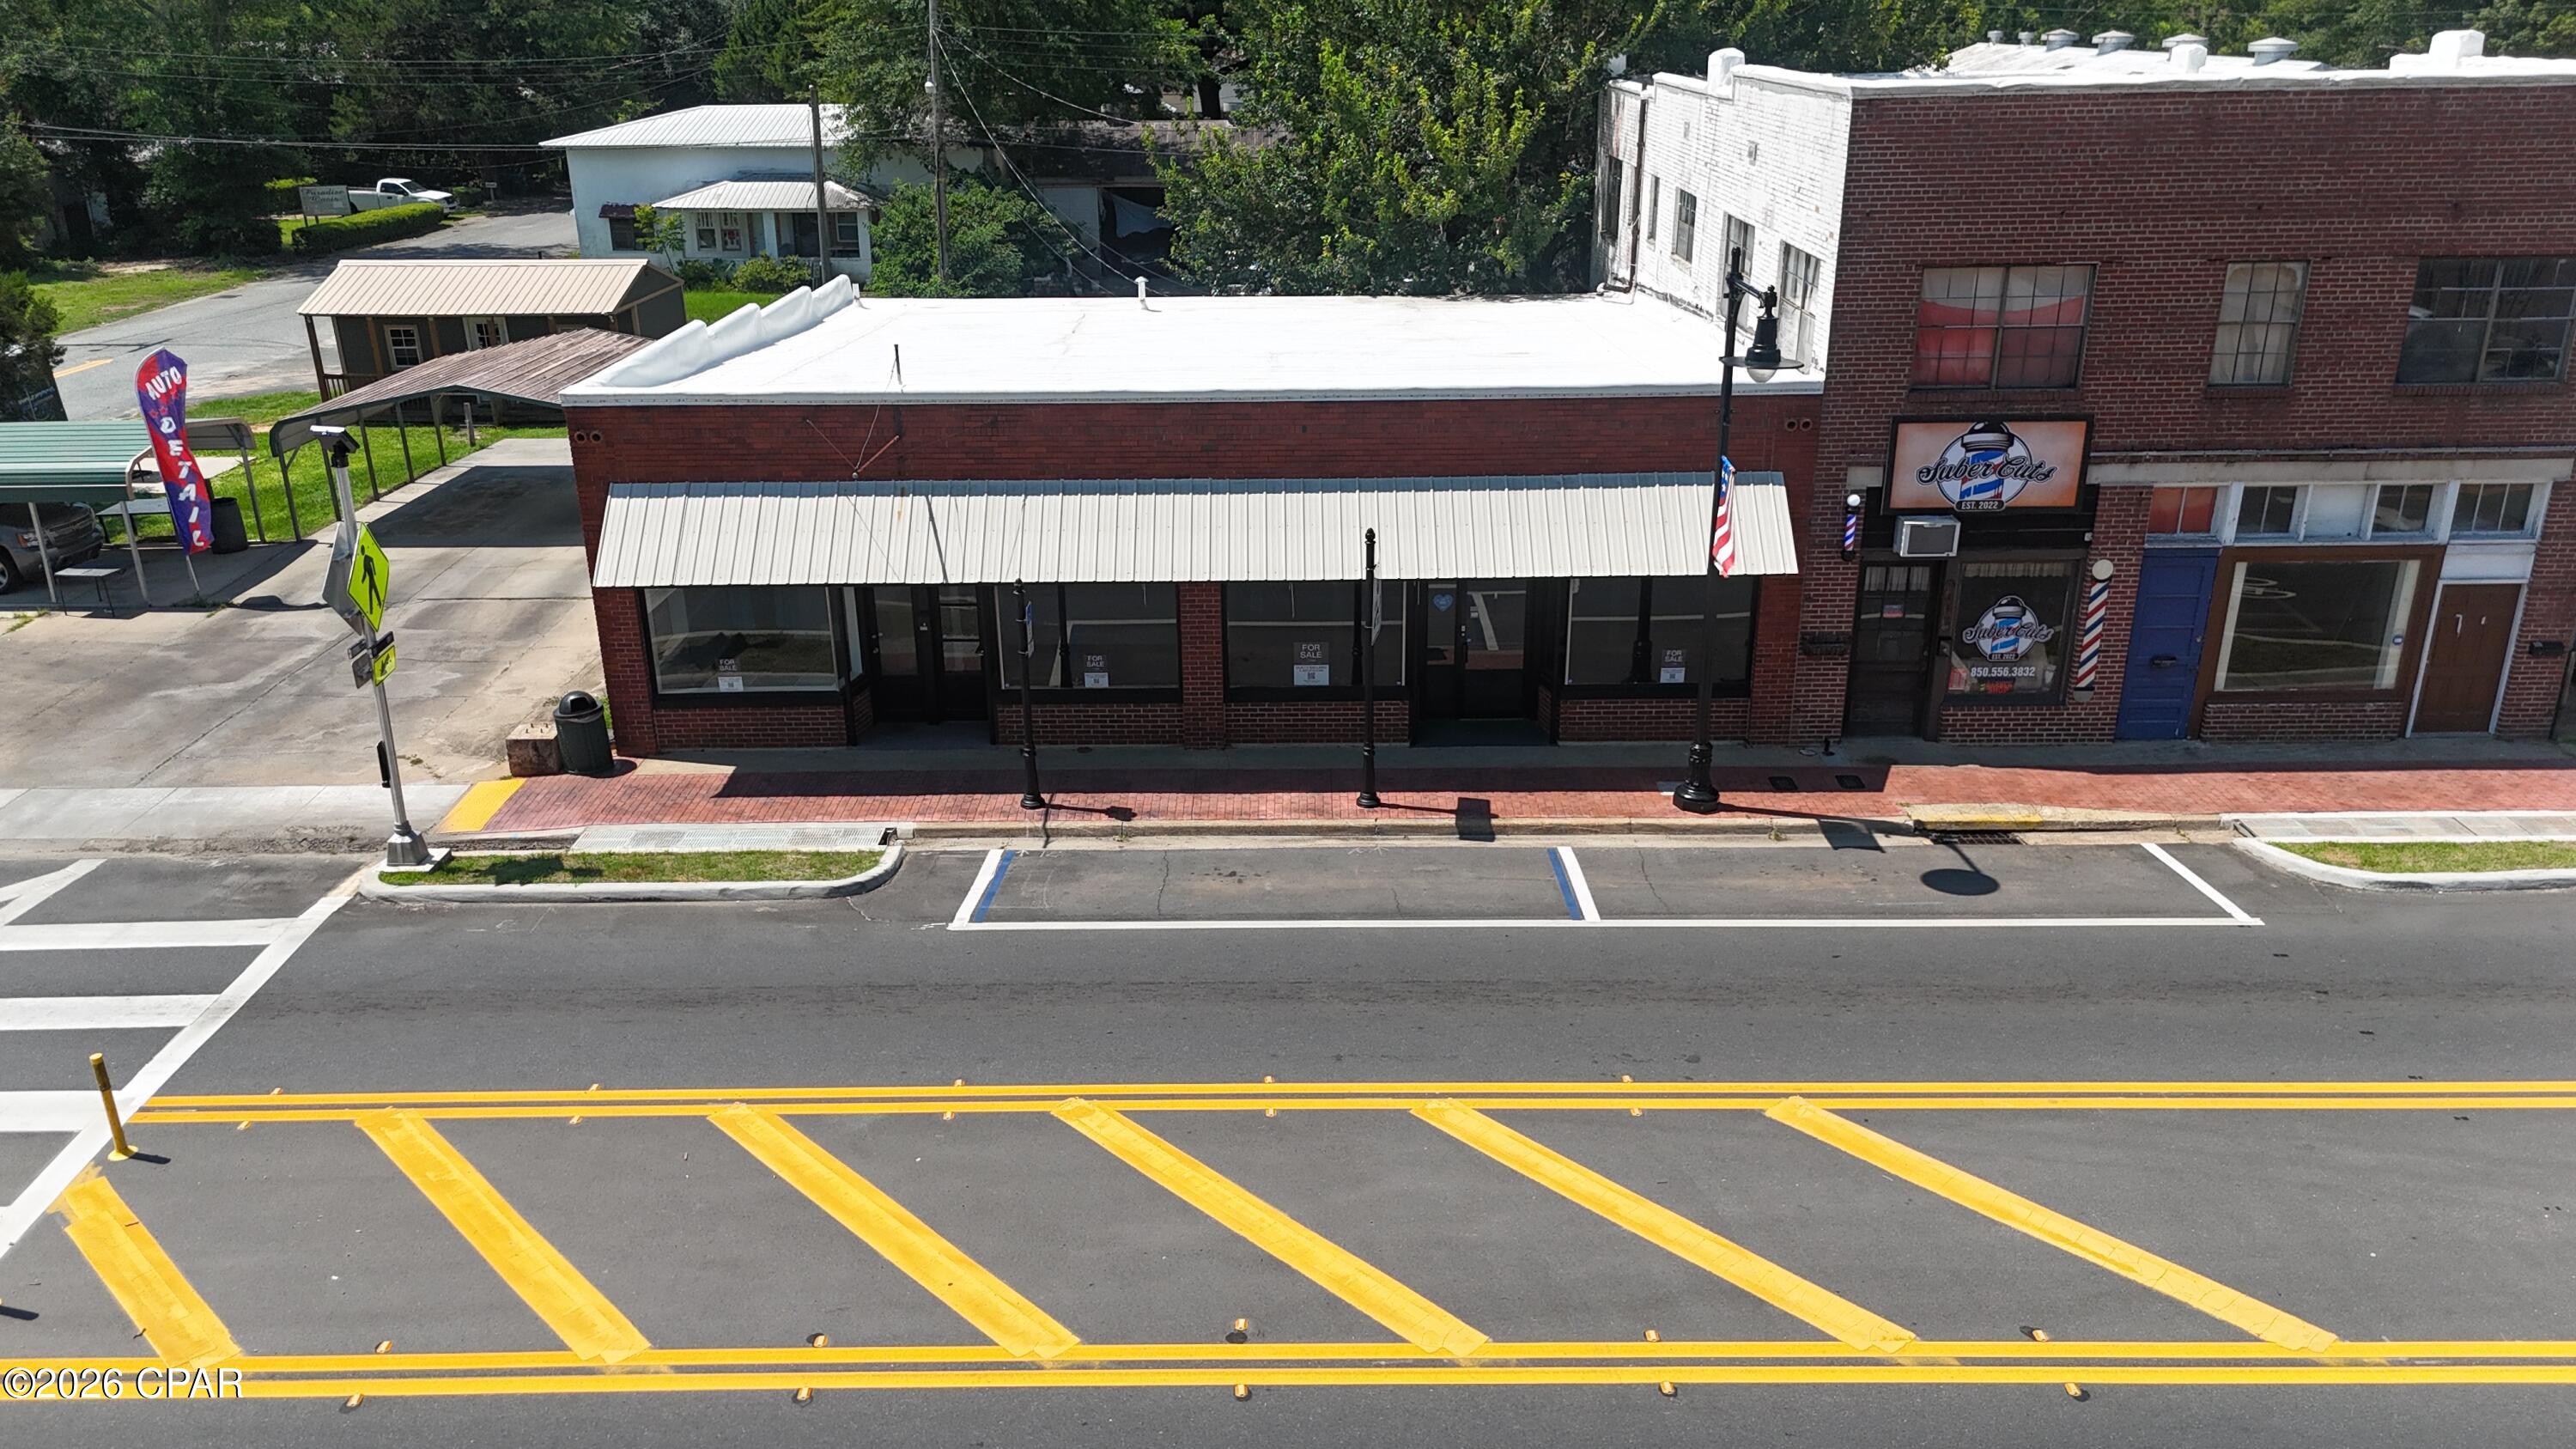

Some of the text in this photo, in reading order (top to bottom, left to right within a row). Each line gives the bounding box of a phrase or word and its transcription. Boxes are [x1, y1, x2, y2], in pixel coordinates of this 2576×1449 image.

[145, 366, 183, 400] AUTO
[160, 417, 204, 547] DETAIL
[1917, 454, 2057, 485] Suber Cuts
[1960, 501, 1999, 509] EST. 2022
[1962, 622, 2055, 643] Suber Cuts
[1971, 667, 2036, 677] 850.556.3832
